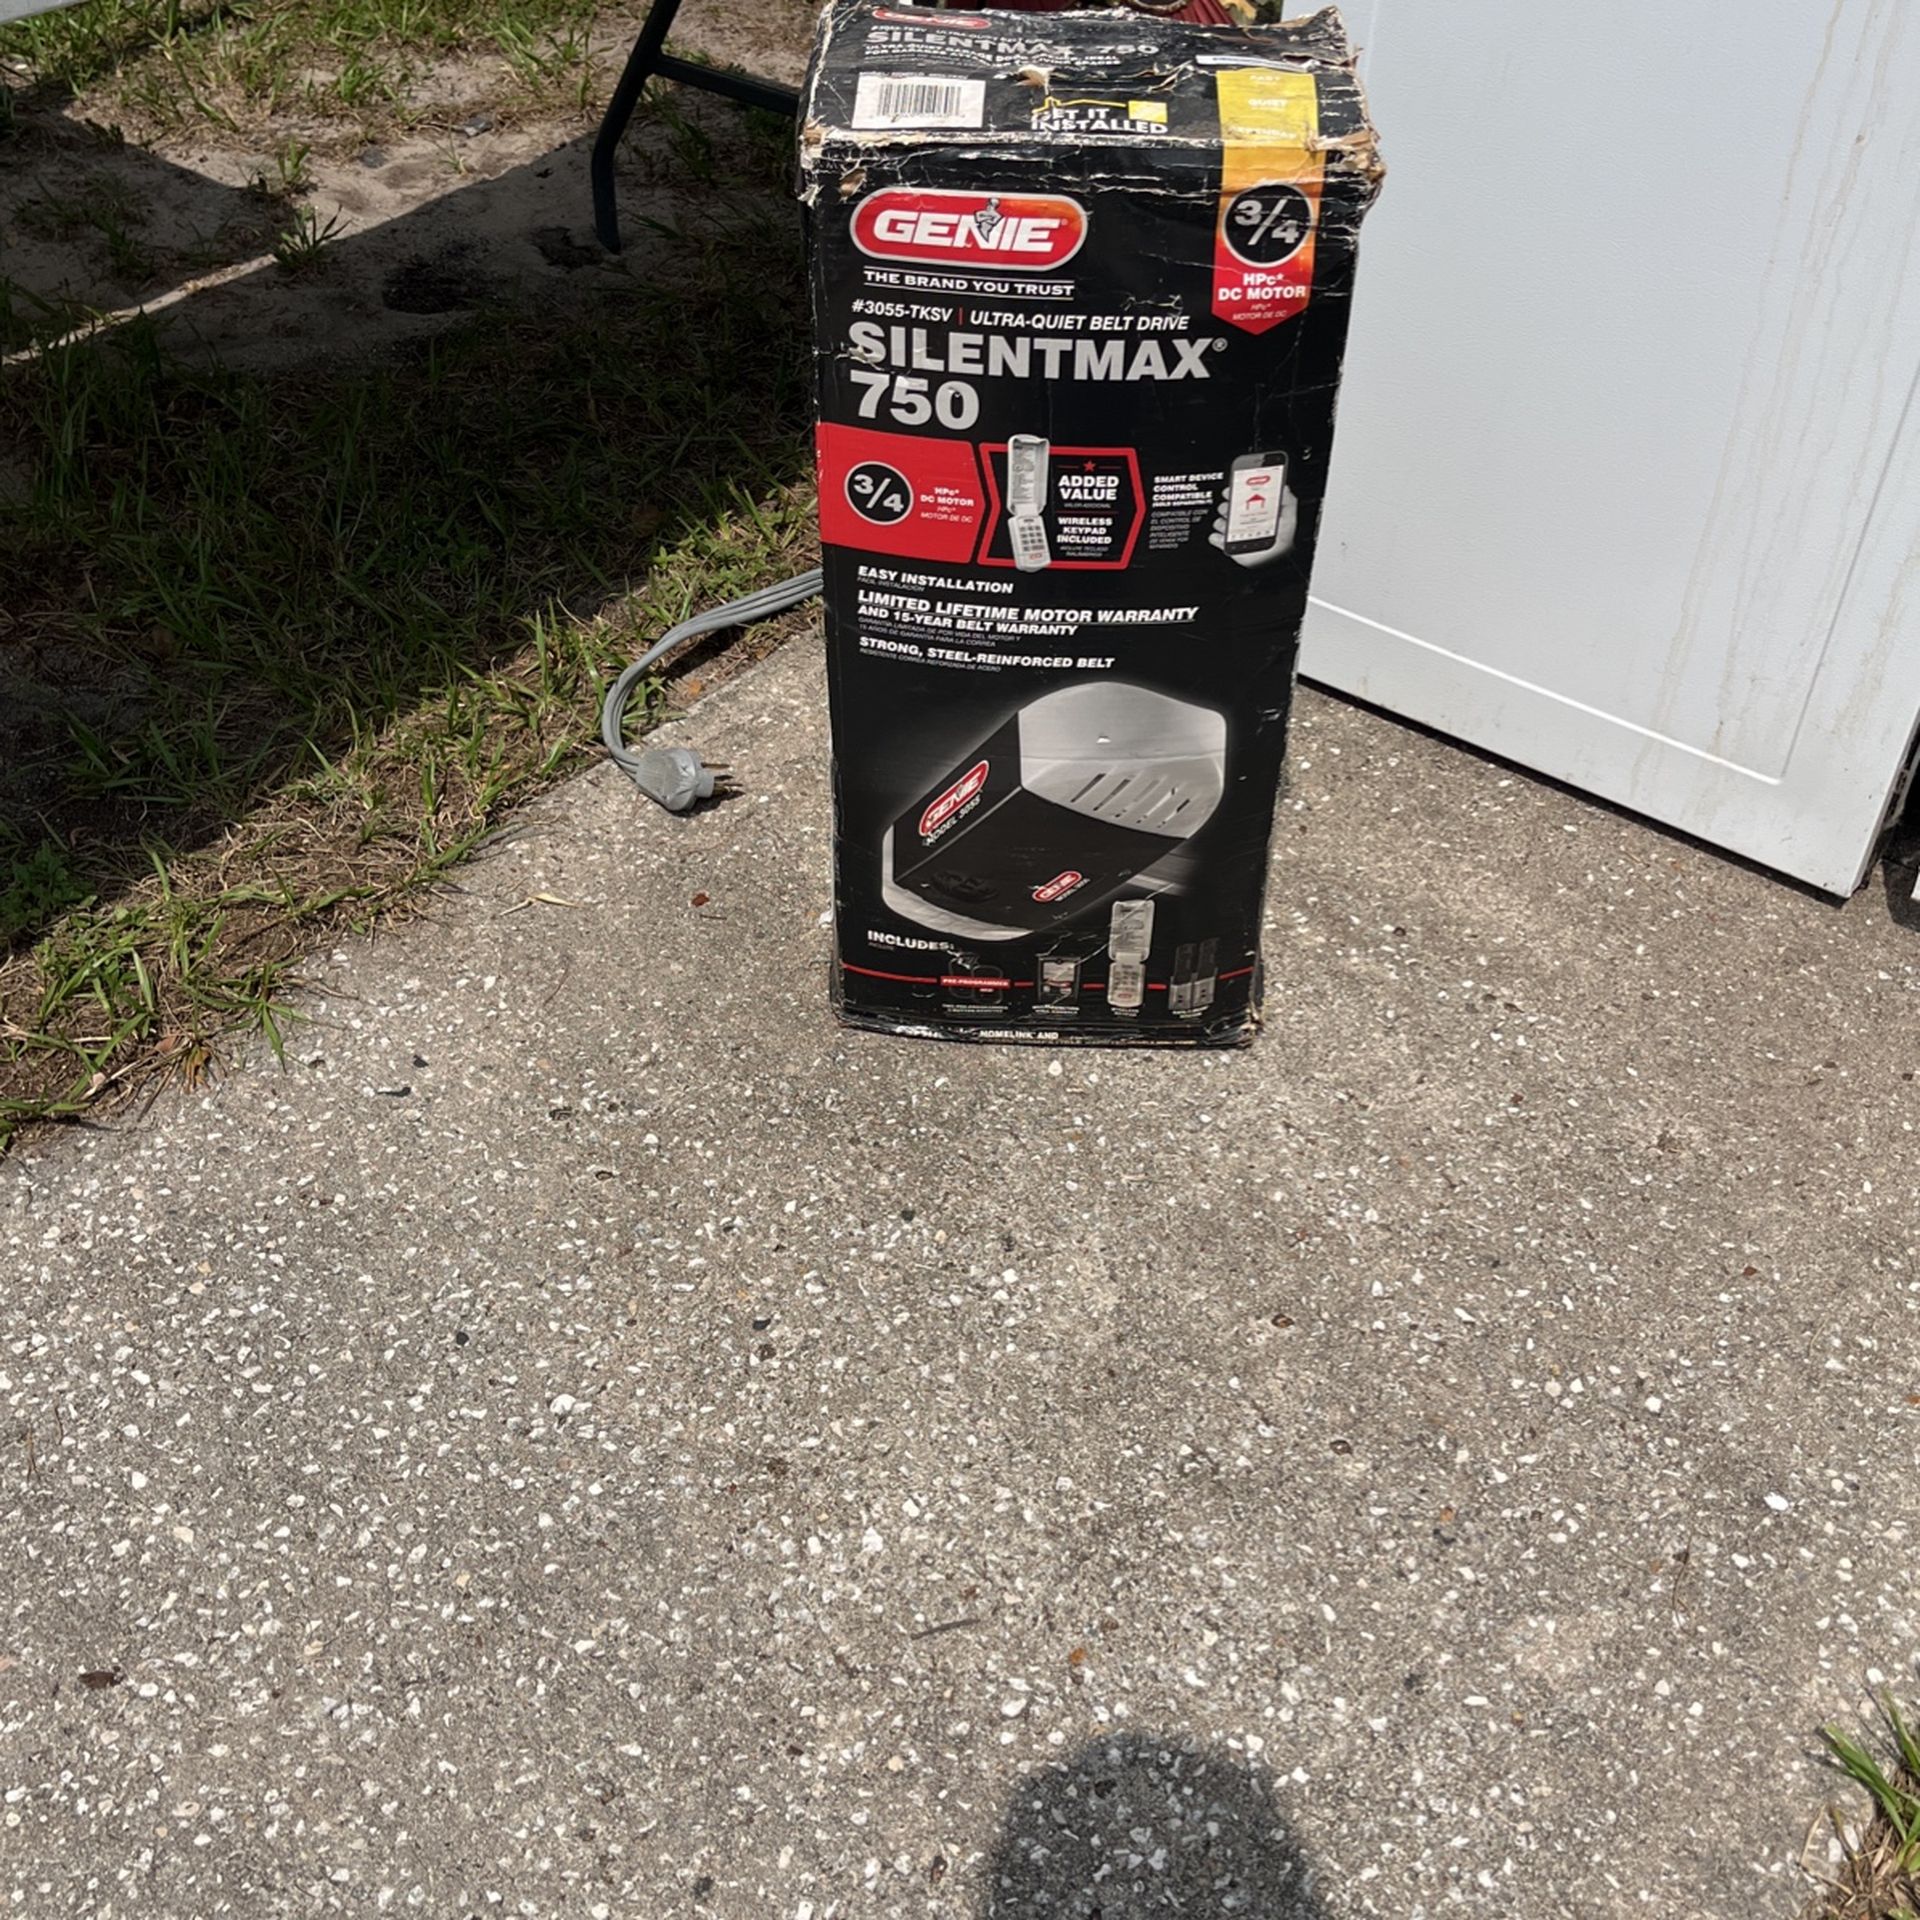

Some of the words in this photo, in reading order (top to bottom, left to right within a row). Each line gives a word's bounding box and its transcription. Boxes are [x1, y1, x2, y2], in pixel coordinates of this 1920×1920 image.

[866, 31, 1074, 54] SILENTMAX
[1095, 45, 1160, 55] 750
[1087, 108, 1110, 119] IT
[1031, 117, 1168, 134] INSTALLED
[873, 208, 1061, 253] GENIE
[1234, 199, 1300, 246] 3/4
[864, 270, 901, 284] THE
[904, 274, 969, 291] BRAND
[973, 280, 1009, 294] YOU
[1014, 283, 1075, 296] TRUST
[1218, 287, 1243, 301] DC
[1246, 285, 1307, 300] MOTOR
[852, 299, 953, 322] #3055-TKSV
[970, 310, 1087, 330] ULTRA-QUIET
[1089, 315, 1135, 331] BELT
[1136, 315, 1191, 331] DRIVE
[850, 369, 980, 430] 750
[1058, 475, 1120, 488] ADDED
[1154, 475, 1187, 483] SMART
[1188, 472, 1224, 482] DEVICE
[853, 473, 904, 512] 3/4
[1060, 488, 1118, 500] VALUE
[1152, 490, 1213, 501] COMPATIBLE
[1153, 483, 1199, 492] CONTROL
[920, 494, 935, 503] DC
[937, 495, 974, 506] MOTOR
[1057, 517, 1113, 526] WIRELESS
[1063, 526, 1107, 535] KEYPAD
[1057, 535, 1112, 544] INCLUDED
[858, 565, 898, 581] EASY
[900, 572, 1014, 594] INSTALLATION
[858, 589, 931, 612] LIMITED
[935, 601, 1020, 620] LIFETIME
[1024, 608, 1093, 623] MOTOR
[1097, 607, 1200, 622] WARRANTY
[857, 605, 889, 619] AND
[893, 610, 953, 628] 15-YEAR
[956, 619, 994, 632] BELT
[996, 623, 1079, 636] WARRANTY
[859, 636, 923, 657] STRONG,
[926, 647, 1073, 668] STEEL-REINFORCED
[1076, 657, 1115, 668] BELT
[924, 770, 982, 830] GENIE
[867, 930, 954, 950] INCLUDES:
[1037, 1031, 1059, 1040] AND
